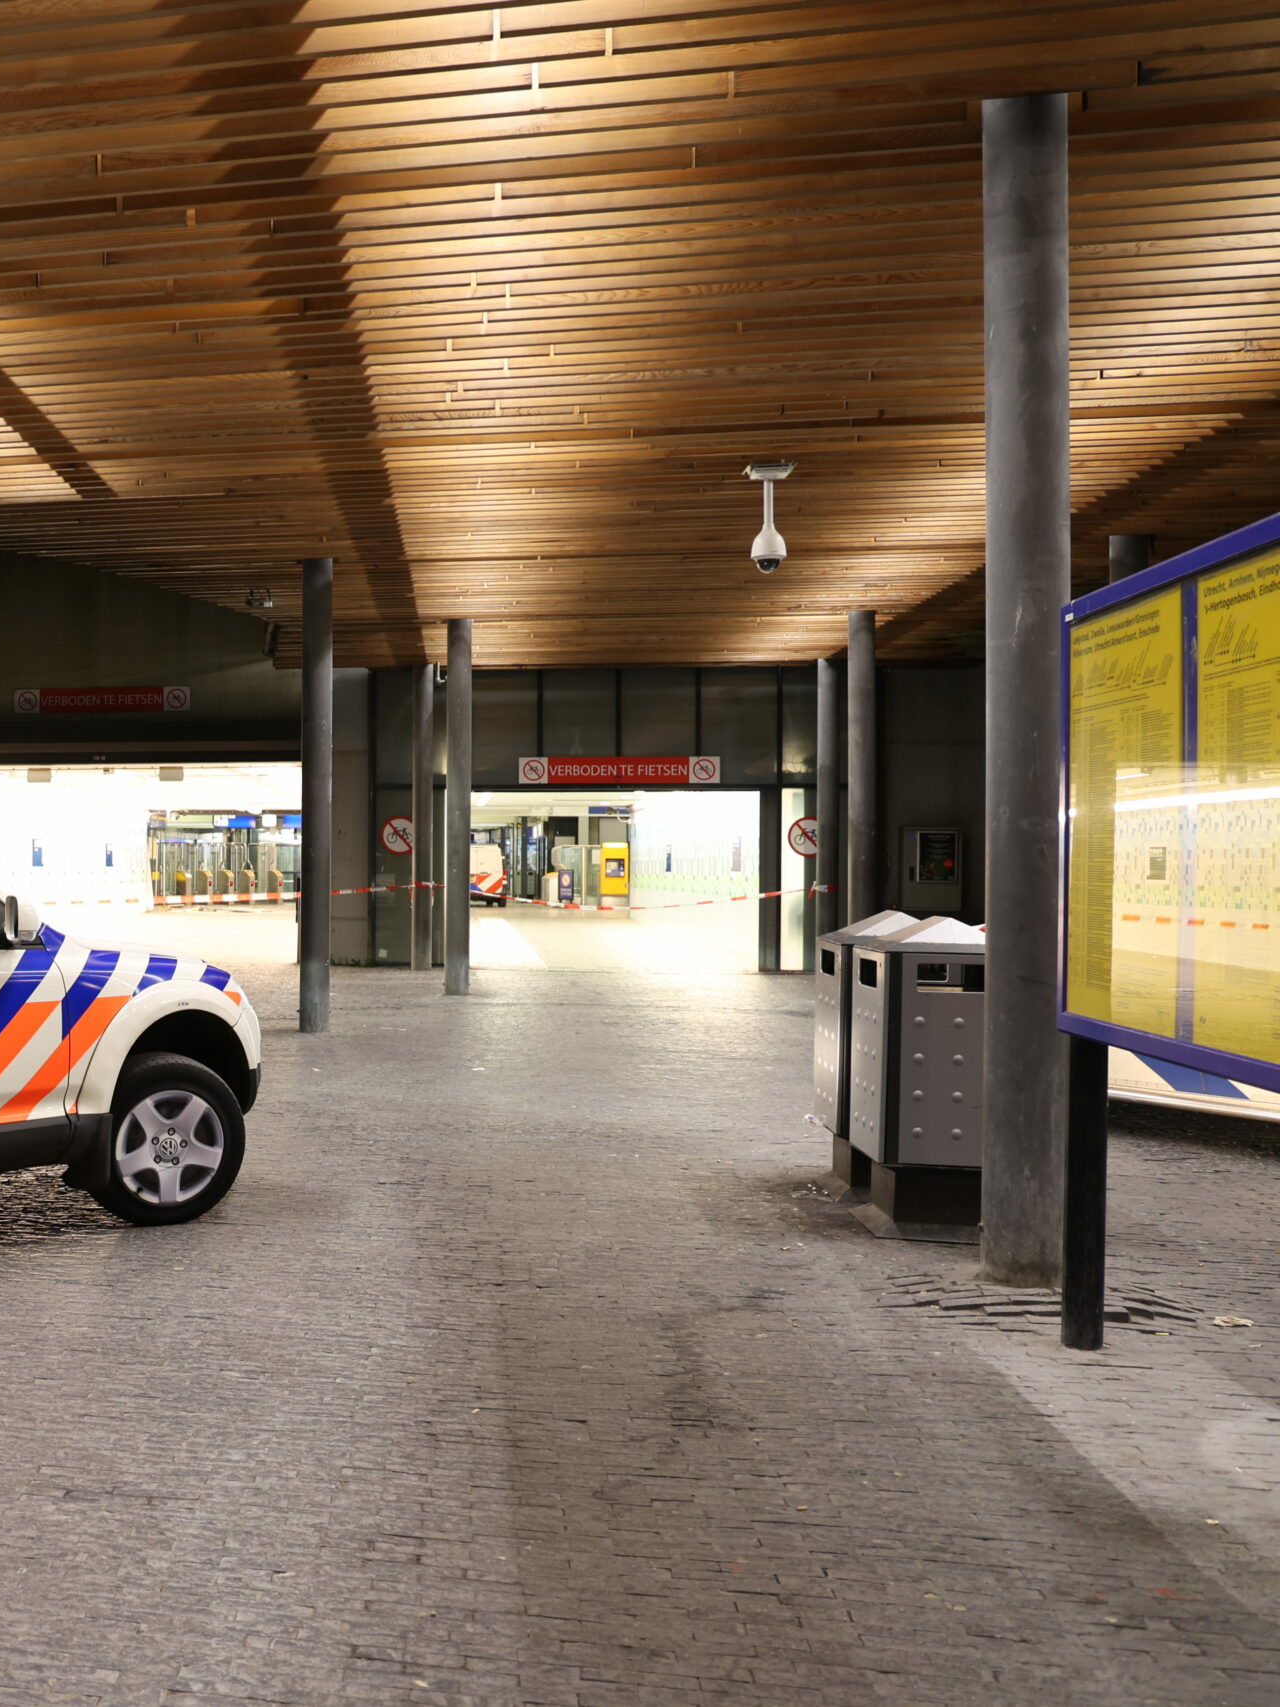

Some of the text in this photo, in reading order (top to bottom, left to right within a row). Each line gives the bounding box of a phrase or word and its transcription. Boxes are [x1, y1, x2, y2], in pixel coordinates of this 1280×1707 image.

[41, 693, 162, 706] VERBODEN TE FIETSEN
[549, 764, 688, 777] VERBODEN TE FIETSEN
